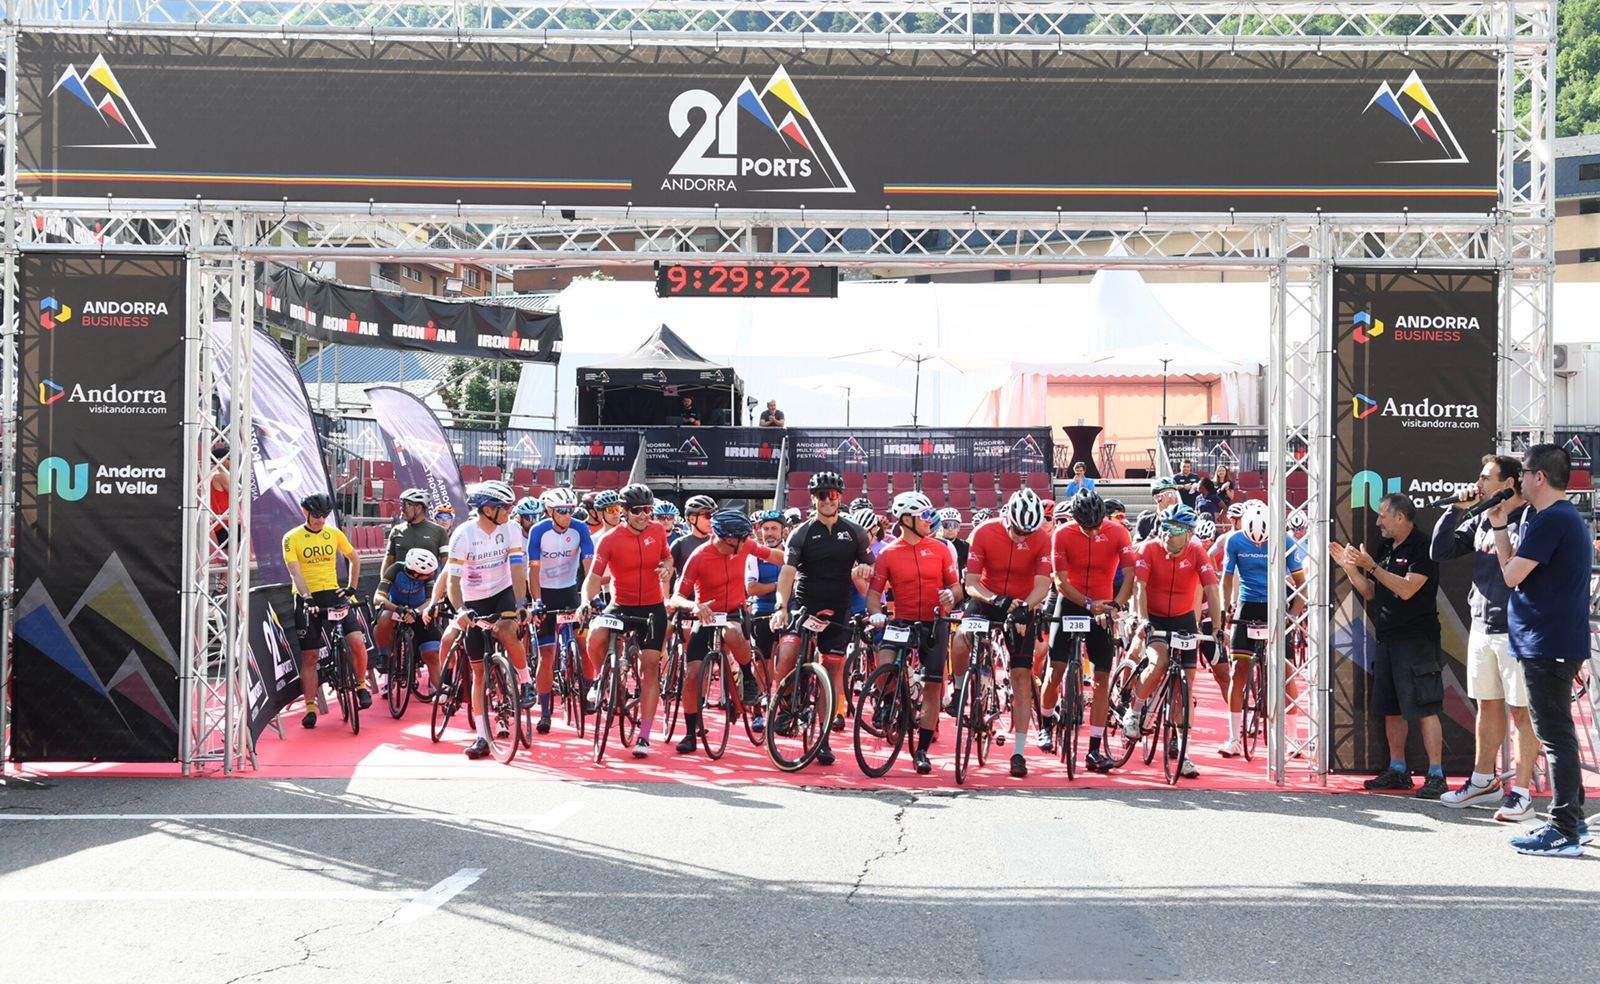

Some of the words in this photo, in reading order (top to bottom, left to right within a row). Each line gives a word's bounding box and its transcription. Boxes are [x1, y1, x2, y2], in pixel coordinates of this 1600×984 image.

[741, 158, 812, 177] PORTS
[660, 179, 738, 191] ANDORRA
[667, 266, 811, 293] 9:29:22
[82, 301, 168, 315] ANDORRA
[82, 316, 149, 327] BUSINESS
[322, 313, 379, 336] IRONMAN
[1394, 315, 1480, 330] ANDORRA
[392, 320, 457, 343] IRONMAN
[1394, 331, 1461, 342] BUSINESS
[477, 330, 539, 352] IRONMAN
[68, 383, 167, 404] Andorra
[88, 405, 167, 414] visitandorra.com
[1380, 397, 1479, 418] Andorra
[1401, 419, 1480, 429] visitandorra.com
[555, 440, 625, 456] IRONMAN
[724, 442, 782, 459] IRONMA
[883, 439, 956, 455] IRONMAN
[96, 464, 166, 479] Andorra
[96, 481, 112, 495] la
[114, 481, 158, 495] Vella
[303, 544, 334, 559] ORIO
[542, 550, 572, 559] ZONE
[605, 619, 618, 627] 178
